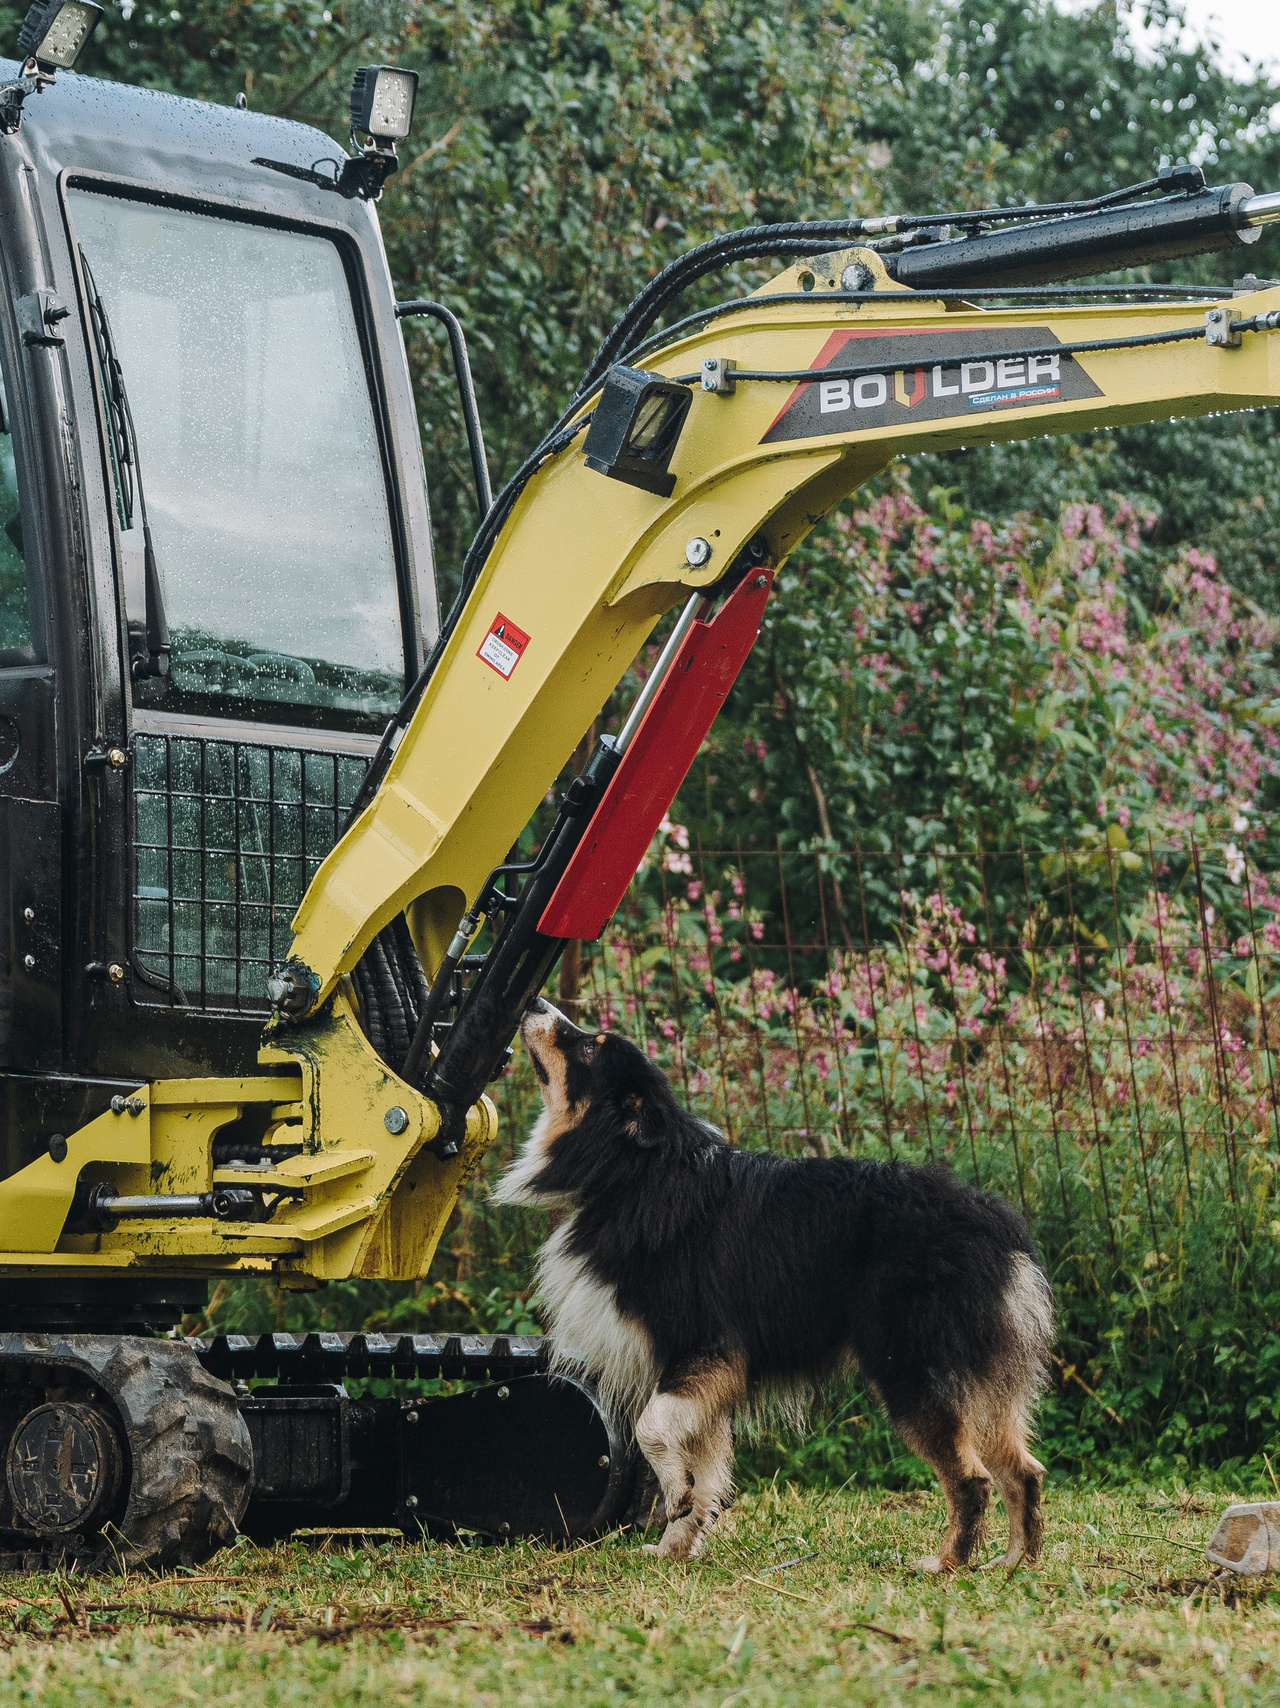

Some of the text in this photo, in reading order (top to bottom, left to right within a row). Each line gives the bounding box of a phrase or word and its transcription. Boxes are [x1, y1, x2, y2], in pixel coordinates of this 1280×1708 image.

[821, 353, 1060, 413] BOULDER
[505, 633, 523, 650] DANGER
[498, 650, 510, 661] CLEAR
[495, 660, 505, 671] AREA
